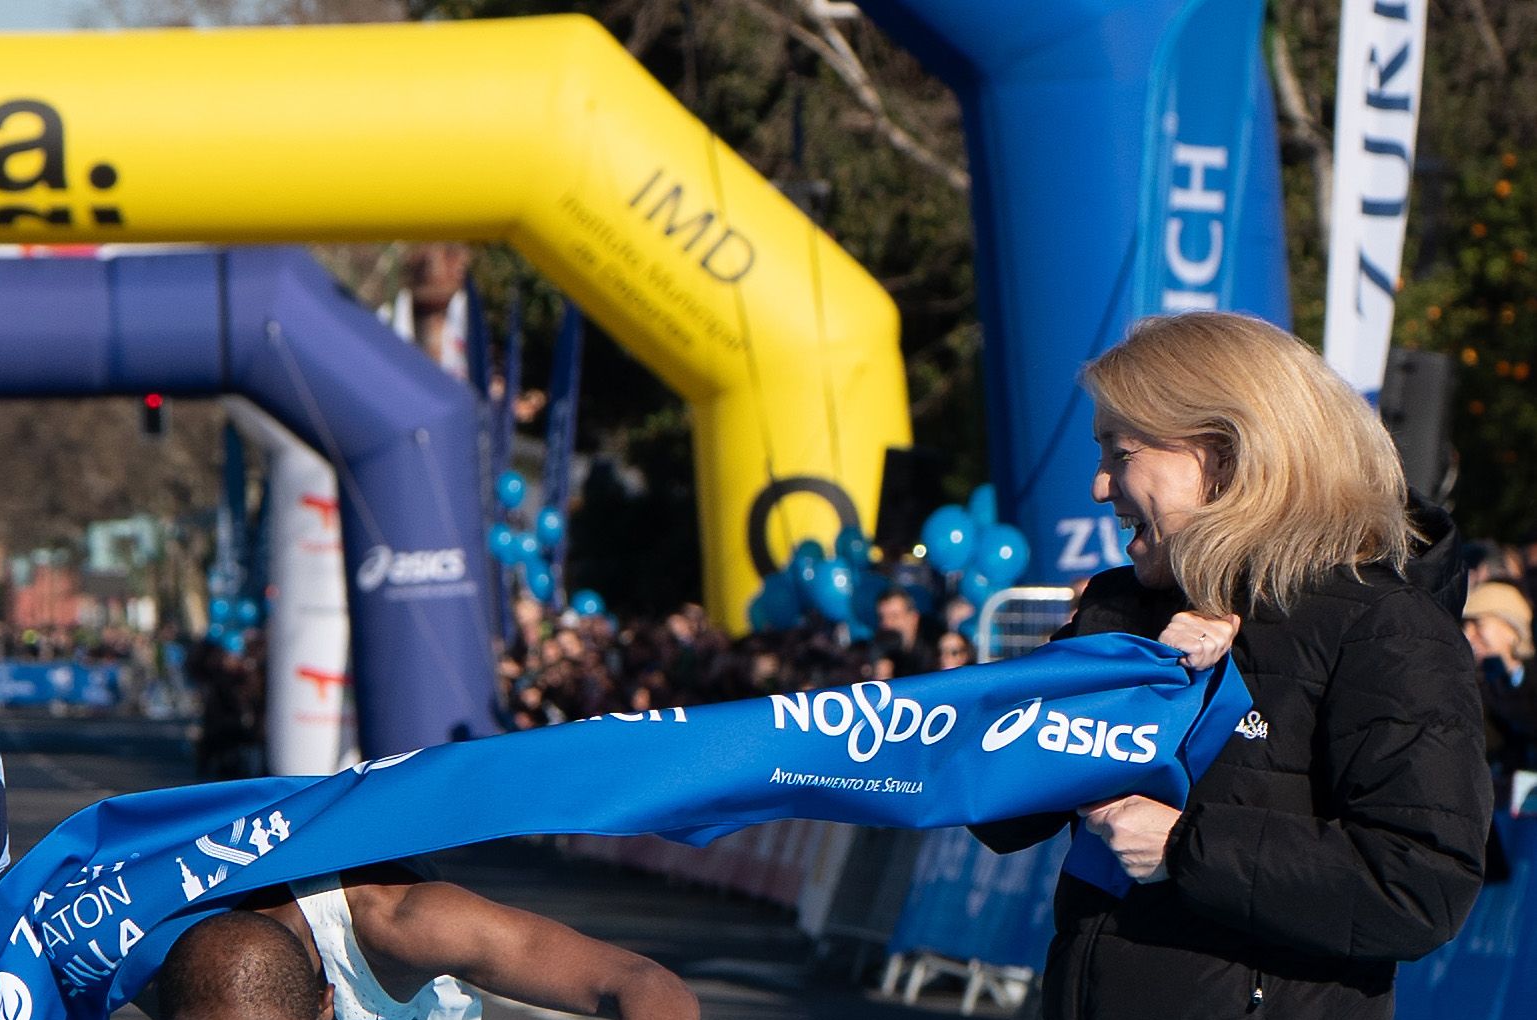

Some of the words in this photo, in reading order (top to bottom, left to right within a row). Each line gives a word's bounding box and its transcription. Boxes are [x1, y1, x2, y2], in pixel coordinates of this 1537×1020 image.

[1355, 2, 1411, 319] ZURI
[628, 168, 756, 284] IMD
[1162, 143, 1229, 312] ICH
[770, 767, 863, 790] AYUNTAMIENTO
[864, 779, 882, 792] DE
[882, 777, 923, 793] SEVILLA
[1037, 710, 1159, 764] asics
